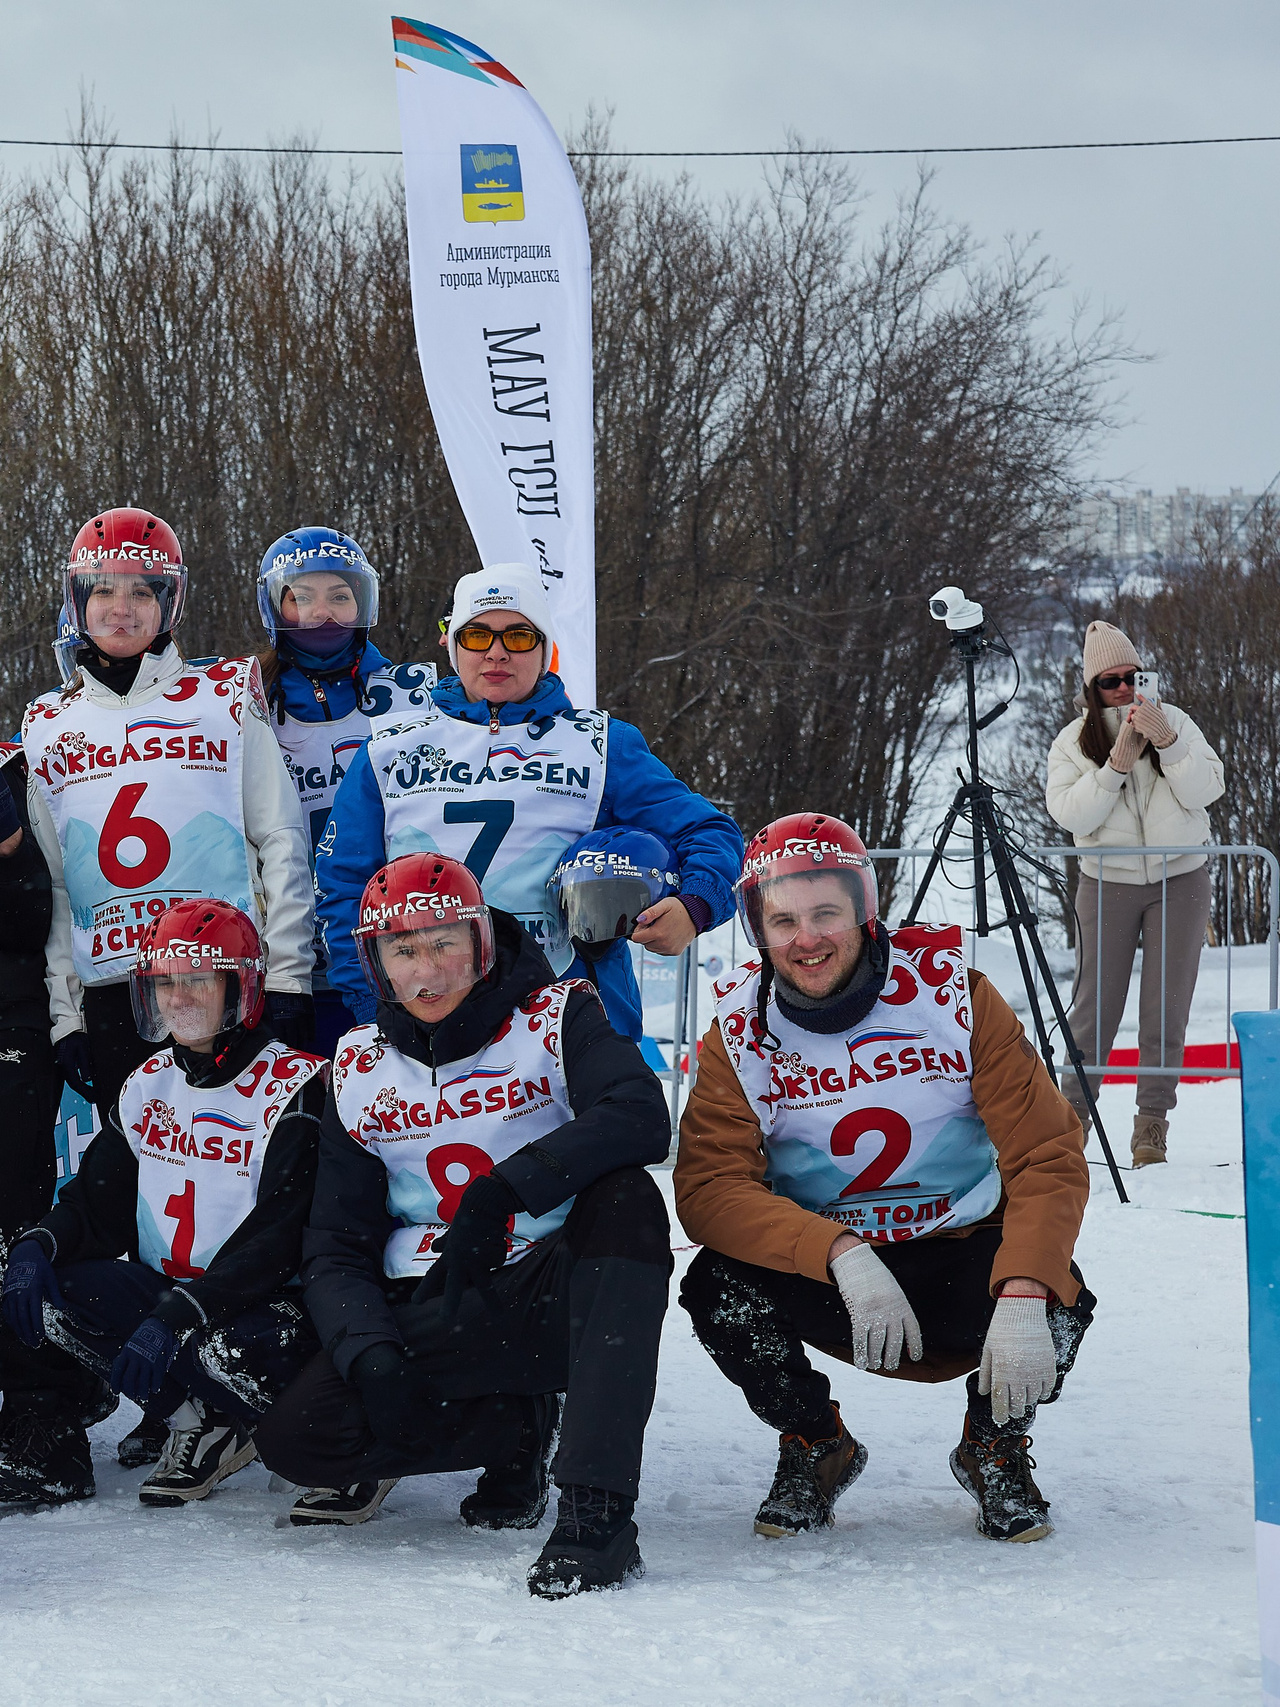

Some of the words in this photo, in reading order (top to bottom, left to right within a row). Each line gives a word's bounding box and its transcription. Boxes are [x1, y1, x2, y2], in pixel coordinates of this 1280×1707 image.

[439, 270, 483, 289] города
[486, 266, 560, 288] Мурманска
[446, 243, 552, 263] Администрация
[483, 323, 552, 422] МАУ
[90, 772, 112, 781] REGION
[98, 782, 171, 889] 6
[443, 800, 515, 885] 7
[91, 933, 103, 957] В
[816, 1098, 843, 1108] REGION
[830, 1107, 920, 1198] 2
[426, 1143, 515, 1233] 8
[873, 1196, 952, 1225] ТОЛК
[160, 1179, 205, 1279] 1
